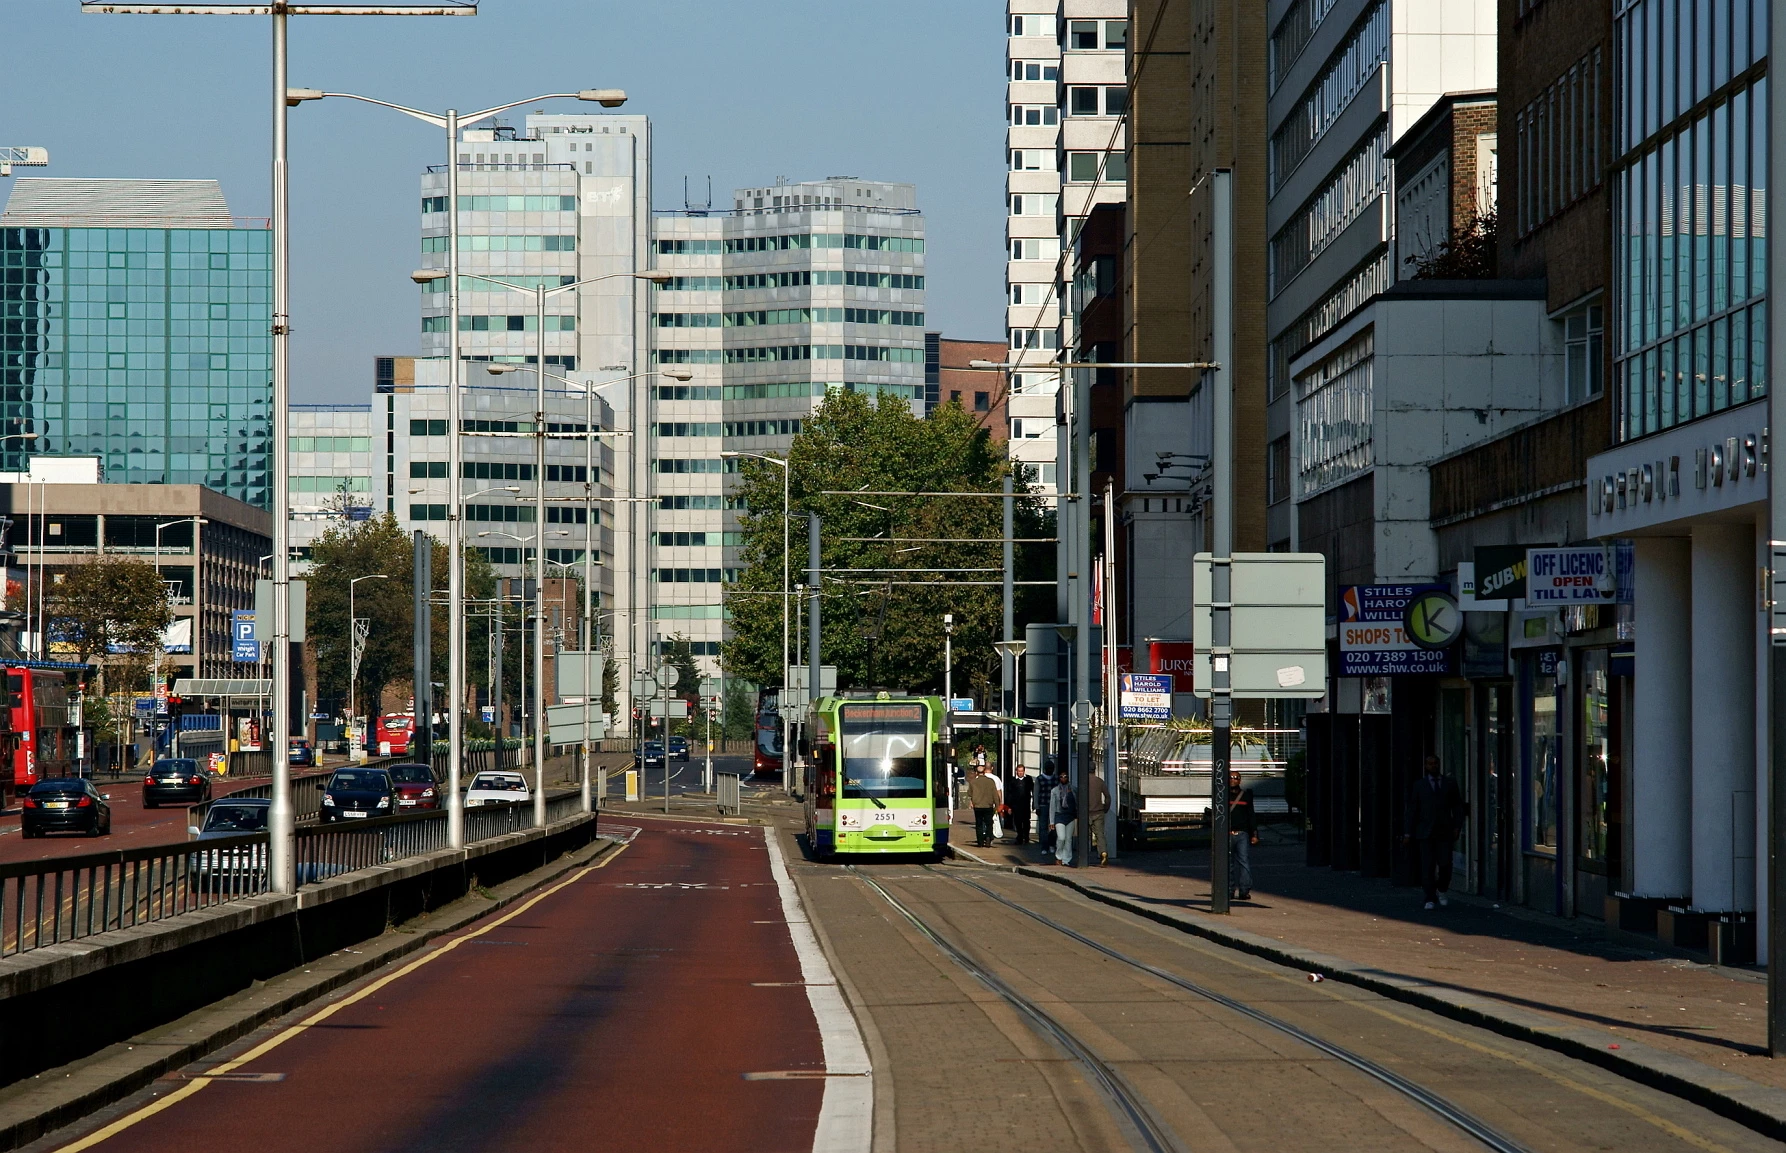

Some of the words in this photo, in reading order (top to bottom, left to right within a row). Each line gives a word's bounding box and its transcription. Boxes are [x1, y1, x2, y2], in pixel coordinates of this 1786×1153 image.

[1591, 455, 1680, 516] NORFOLK
[1533, 553, 1556, 577] OFF
[1560, 552, 1611, 576] LICENC
[1481, 559, 1527, 596] SUBW
[1553, 576, 1593, 587] OPEN
[1364, 587, 1413, 597] STILES
[1534, 589, 1568, 600] TILL
[1572, 588, 1600, 600] LAT
[240, 624, 252, 639] P
[1346, 628, 1391, 645] SHOPS
[1346, 652, 1370, 663] 020
[1374, 651, 1407, 662] 7389
[1411, 650, 1444, 662] 1500
[1346, 662, 1444, 674] www.shw.co.uk
[844, 708, 884, 718] Beckenham
[885, 708, 913, 717] Junction
[912, 707, 920, 720] 2
[875, 813, 895, 821] 2551
